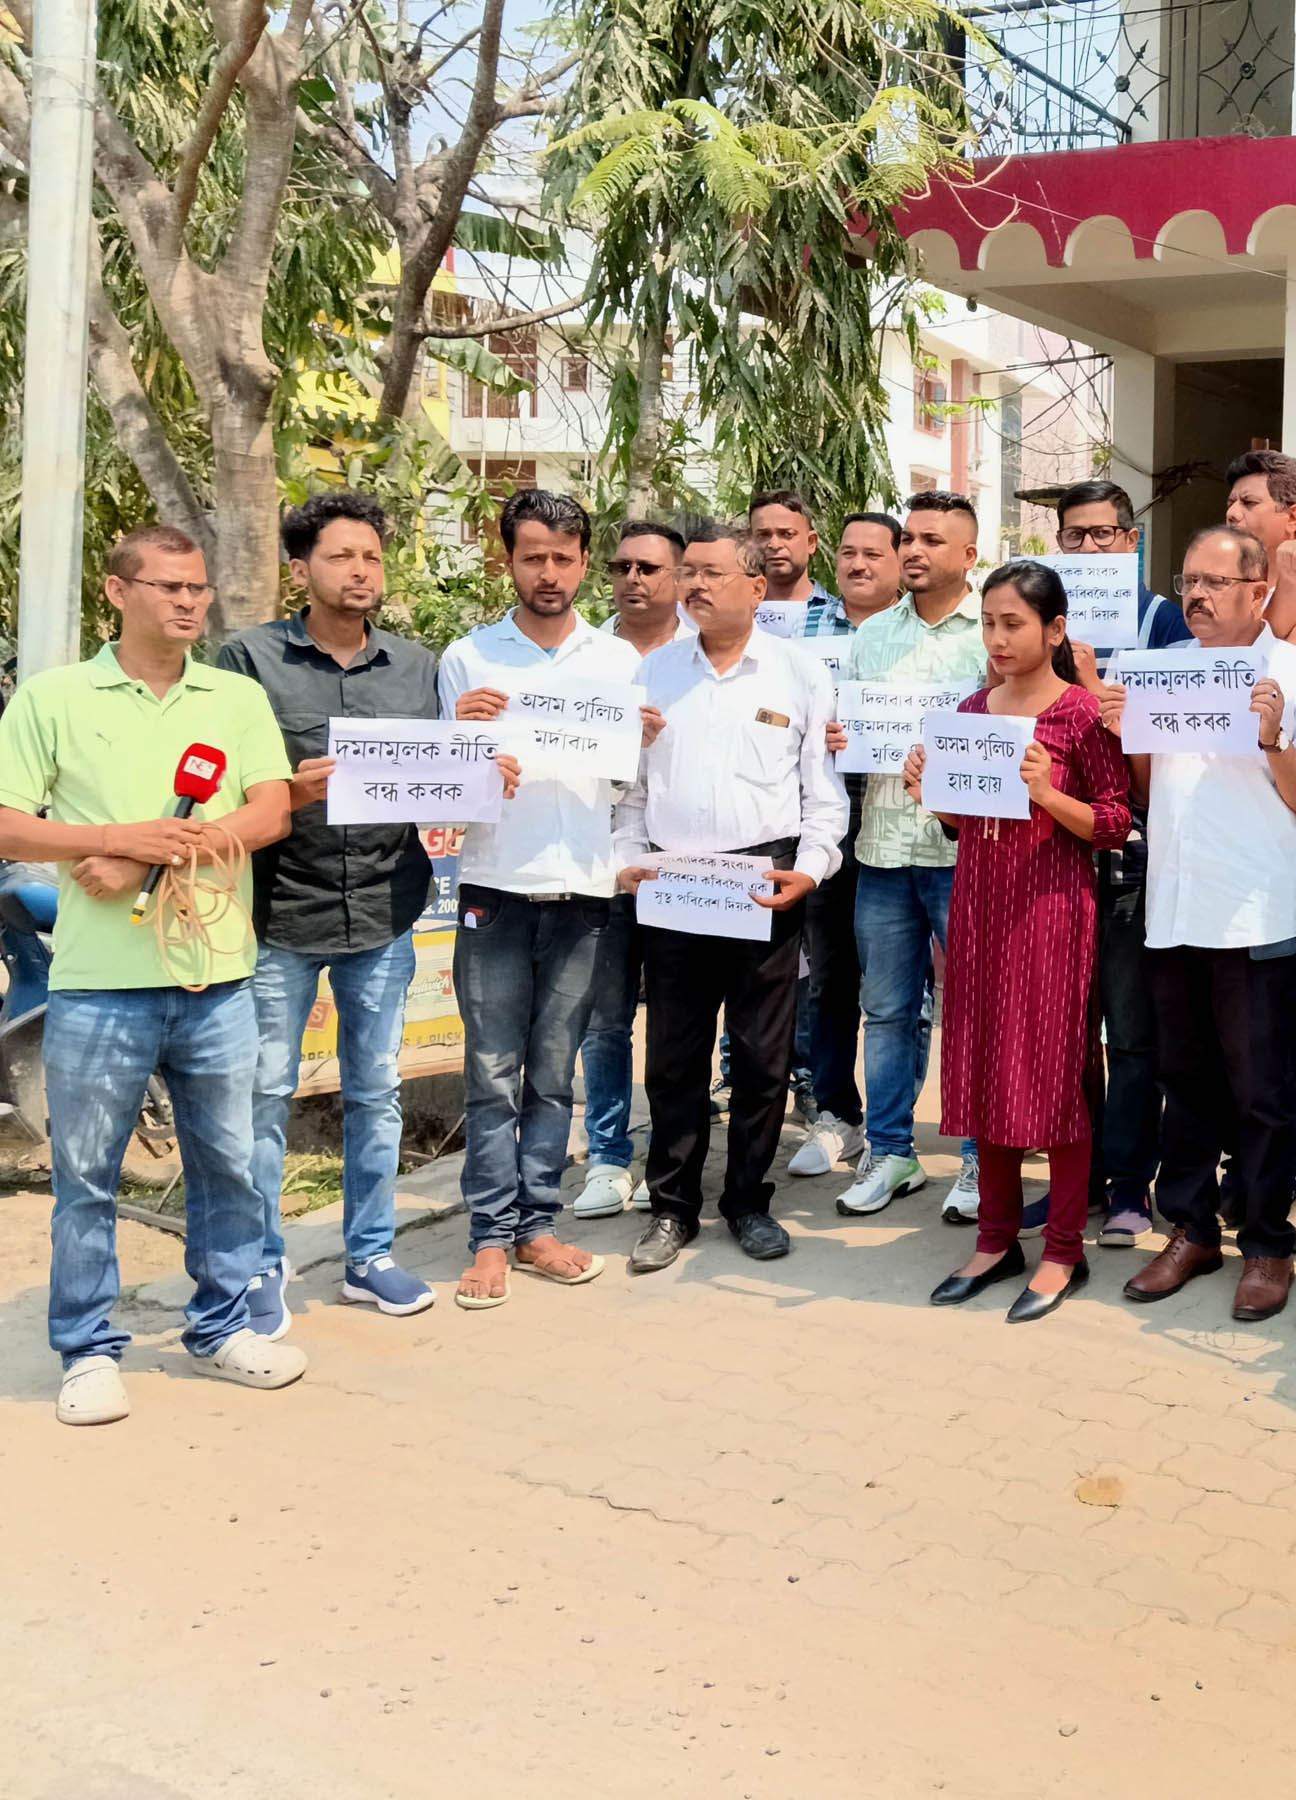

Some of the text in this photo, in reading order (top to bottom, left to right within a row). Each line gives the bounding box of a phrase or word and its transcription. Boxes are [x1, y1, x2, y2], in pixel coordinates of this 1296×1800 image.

[1120, 660, 1256, 695] দমনমূলক নীতি
[520, 692, 624, 722] অসম পুলিচ
[1149, 713, 1231, 733] বন্ধ কৰক
[334, 734, 498, 766] দমনমূলক নীতি
[935, 733, 1015, 760] অসম পুলিচ
[364, 782, 399, 801] বন্ধ
